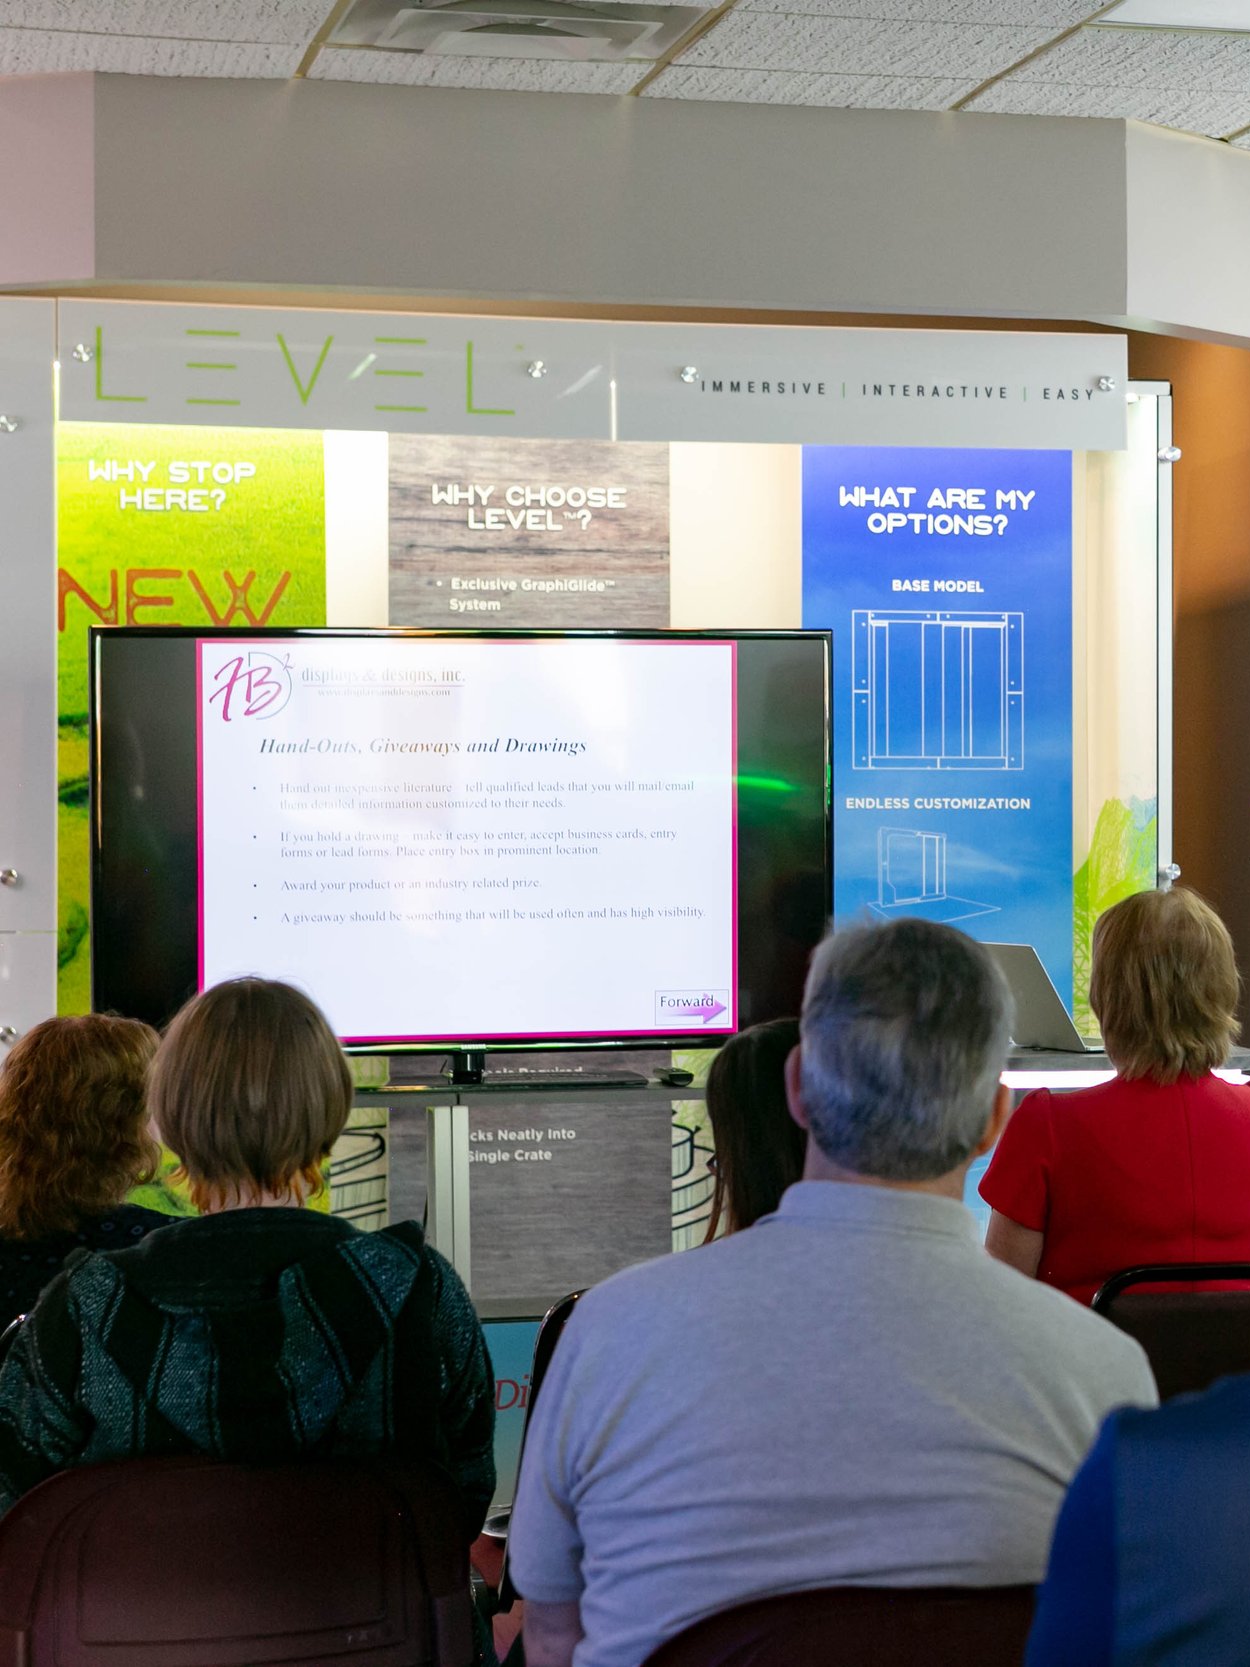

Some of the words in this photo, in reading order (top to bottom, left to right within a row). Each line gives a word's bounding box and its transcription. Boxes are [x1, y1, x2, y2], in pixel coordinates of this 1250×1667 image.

[96, 326, 515, 417] LEVEL
[700, 380, 827, 396] IMMERSIVE
[861, 383, 1009, 399] INTERACTIVE
[1043, 387, 1095, 402] EASY
[88, 459, 156, 482] WHY
[168, 461, 256, 484] STOP
[119, 487, 226, 512] HERE?
[431, 483, 495, 506] WHY
[505, 485, 627, 509] CHOOSE
[839, 485, 917, 508] WHAT
[927, 487, 986, 510] ARE
[996, 489, 1036, 511] MY
[867, 512, 1008, 536] OPTIONS?
[451, 578, 517, 591] Exclusive
[892, 579, 930, 592] BASE
[934, 580, 985, 593] MODEL
[58, 568, 291, 632] NEW
[449, 599, 501, 612] System
[382, 667, 437, 684] designs,
[441, 668, 466, 682] inc.
[259, 738, 362, 754] Hand-Outs,
[370, 737, 460, 756] Giveaways
[467, 738, 500, 753] and
[505, 737, 587, 756] Drawings
[280, 783, 311, 793] Hand
[313, 784, 331, 793] out
[334, 783, 400, 796] inexpensive
[403, 782, 453, 793] literature
[465, 782, 483, 793] tell
[486, 781, 534, 795] qualified
[537, 781, 565, 792] leads
[568, 782, 588, 792] that
[591, 783, 611, 794] you
[614, 781, 635, 792] will
[358, 798, 422, 809] information
[425, 798, 488, 809] customized
[490, 798, 502, 809] to
[504, 798, 529, 809] their
[532, 798, 566, 809] needs.
[845, 797, 910, 810] ENDLESS
[913, 797, 1031, 810] CUSTOMIZATION
[280, 831, 291, 842] If
[293, 833, 314, 845] you
[317, 831, 342, 842] hold
[344, 833, 352, 842] a
[354, 831, 400, 845] drawing
[413, 830, 442, 841] make
[446, 830, 454, 841] it
[456, 832, 481, 844] easy
[483, 831, 495, 841] to
[497, 831, 527, 842] enter,
[530, 831, 564, 843] accept
[567, 829, 613, 840] business
[615, 829, 648, 841] cards,
[650, 830, 677, 841] entry
[280, 847, 313, 858] forms
[316, 849, 328, 858] or
[331, 847, 354, 858] lead
[357, 847, 392, 858] forms.
[395, 846, 426, 857] Place
[428, 848, 456, 859] entry
[460, 846, 480, 857] box
[483, 846, 495, 857] in
[497, 845, 553, 858] prominent
[556, 844, 601, 855] location.
[280, 880, 317, 891] Award
[319, 881, 346, 893] your
[349, 879, 391, 892] product
[394, 881, 405, 889] or
[409, 881, 422, 889] an
[425, 878, 468, 891] industry
[472, 878, 509, 889] related
[512, 877, 542, 890] prize.
[280, 913, 290, 923] A
[293, 913, 345, 926] giveaway
[349, 911, 386, 922] should
[389, 911, 402, 921] be
[405, 910, 462, 923] something
[465, 910, 486, 921] that
[488, 909, 510, 920] will
[513, 909, 526, 919] be
[528, 909, 554, 919] used
[556, 908, 584, 919] often
[587, 908, 607, 919] and
[610, 907, 628, 918] has
[631, 907, 654, 920] high
[657, 906, 705, 920] visibility.
[660, 994, 714, 1007] Forward
[497, 1129, 544, 1142] Neatly
[548, 1128, 576, 1140] Into
[468, 1151, 510, 1164] Single
[514, 1149, 553, 1161] Crate
